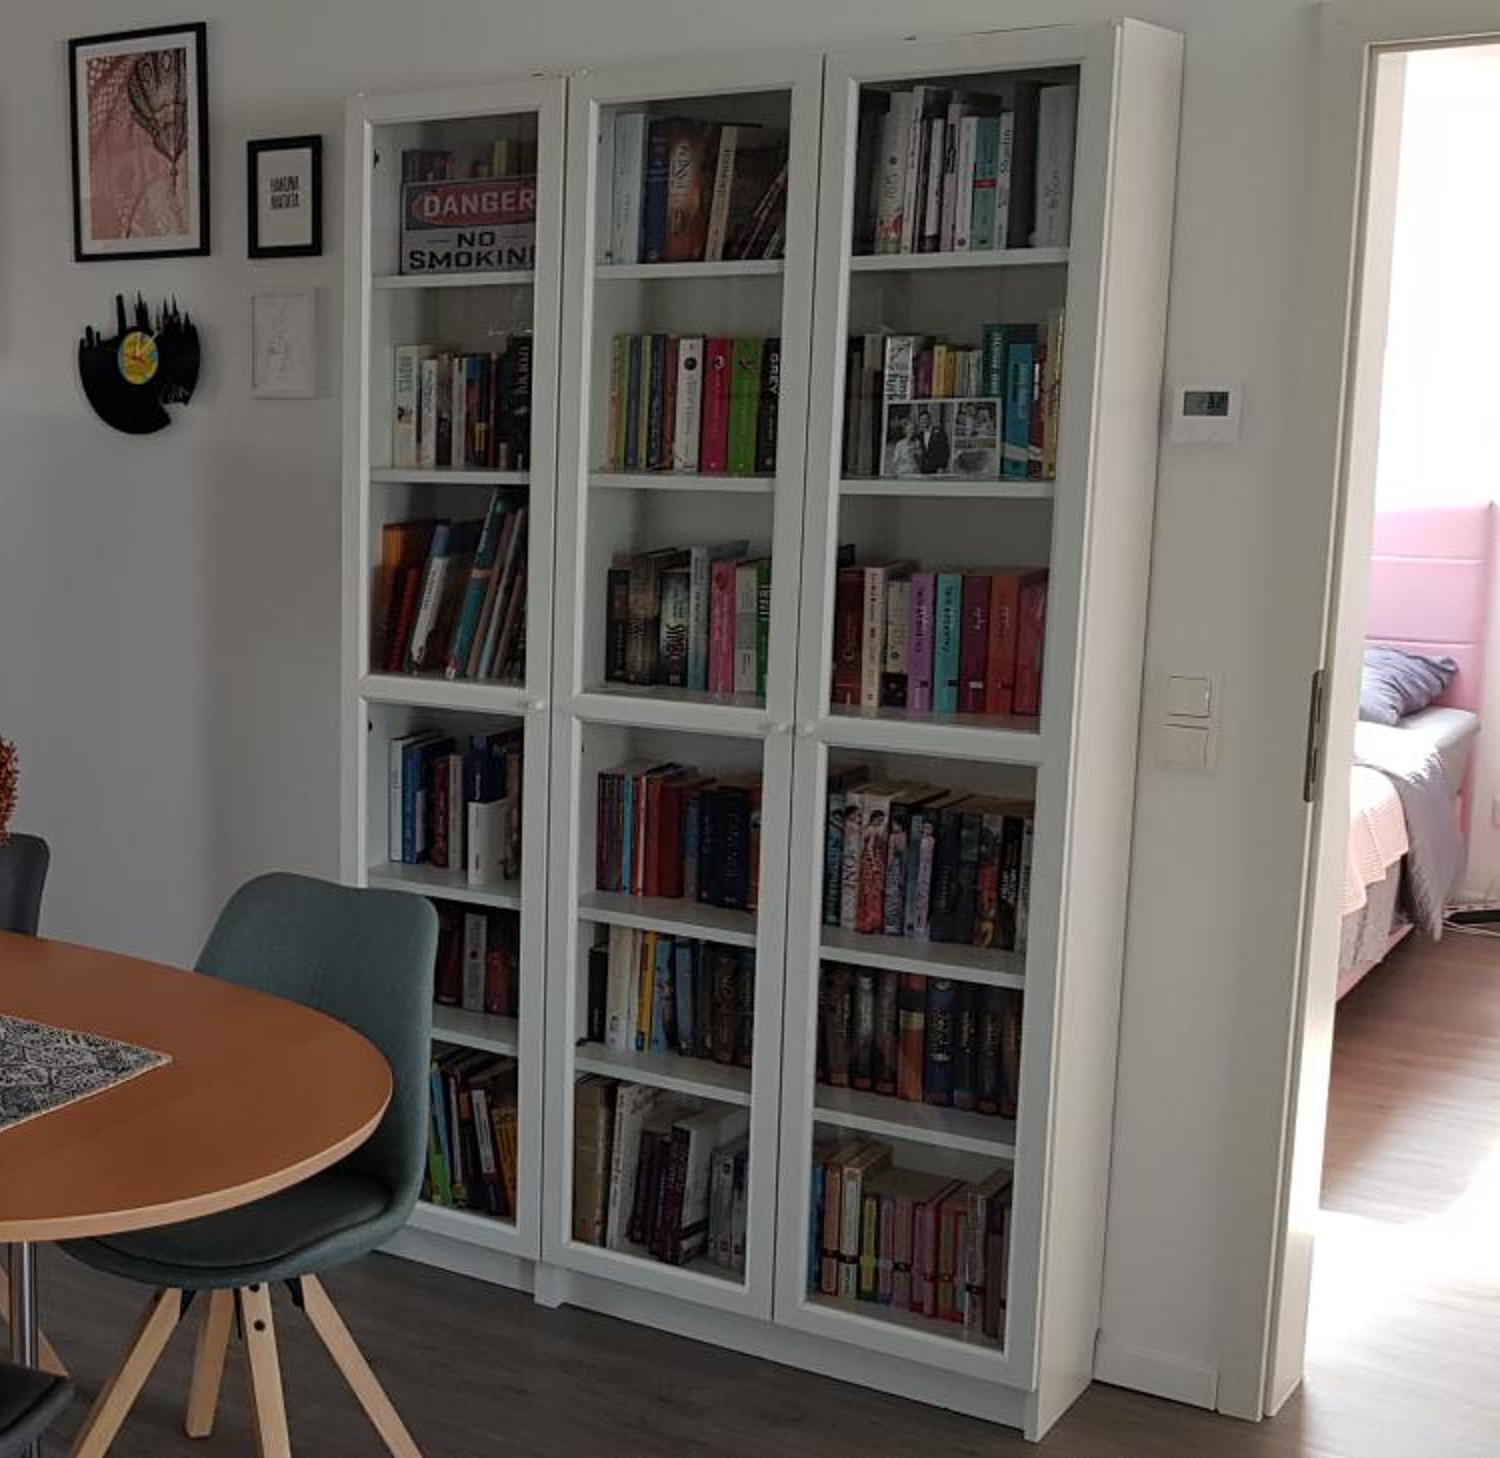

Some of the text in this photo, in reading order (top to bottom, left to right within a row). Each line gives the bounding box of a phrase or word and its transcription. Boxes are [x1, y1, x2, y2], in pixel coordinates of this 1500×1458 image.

[424, 189, 535, 216] DANGER
[458, 231, 496, 248] NO
[409, 245, 535, 270] SMOKIN
